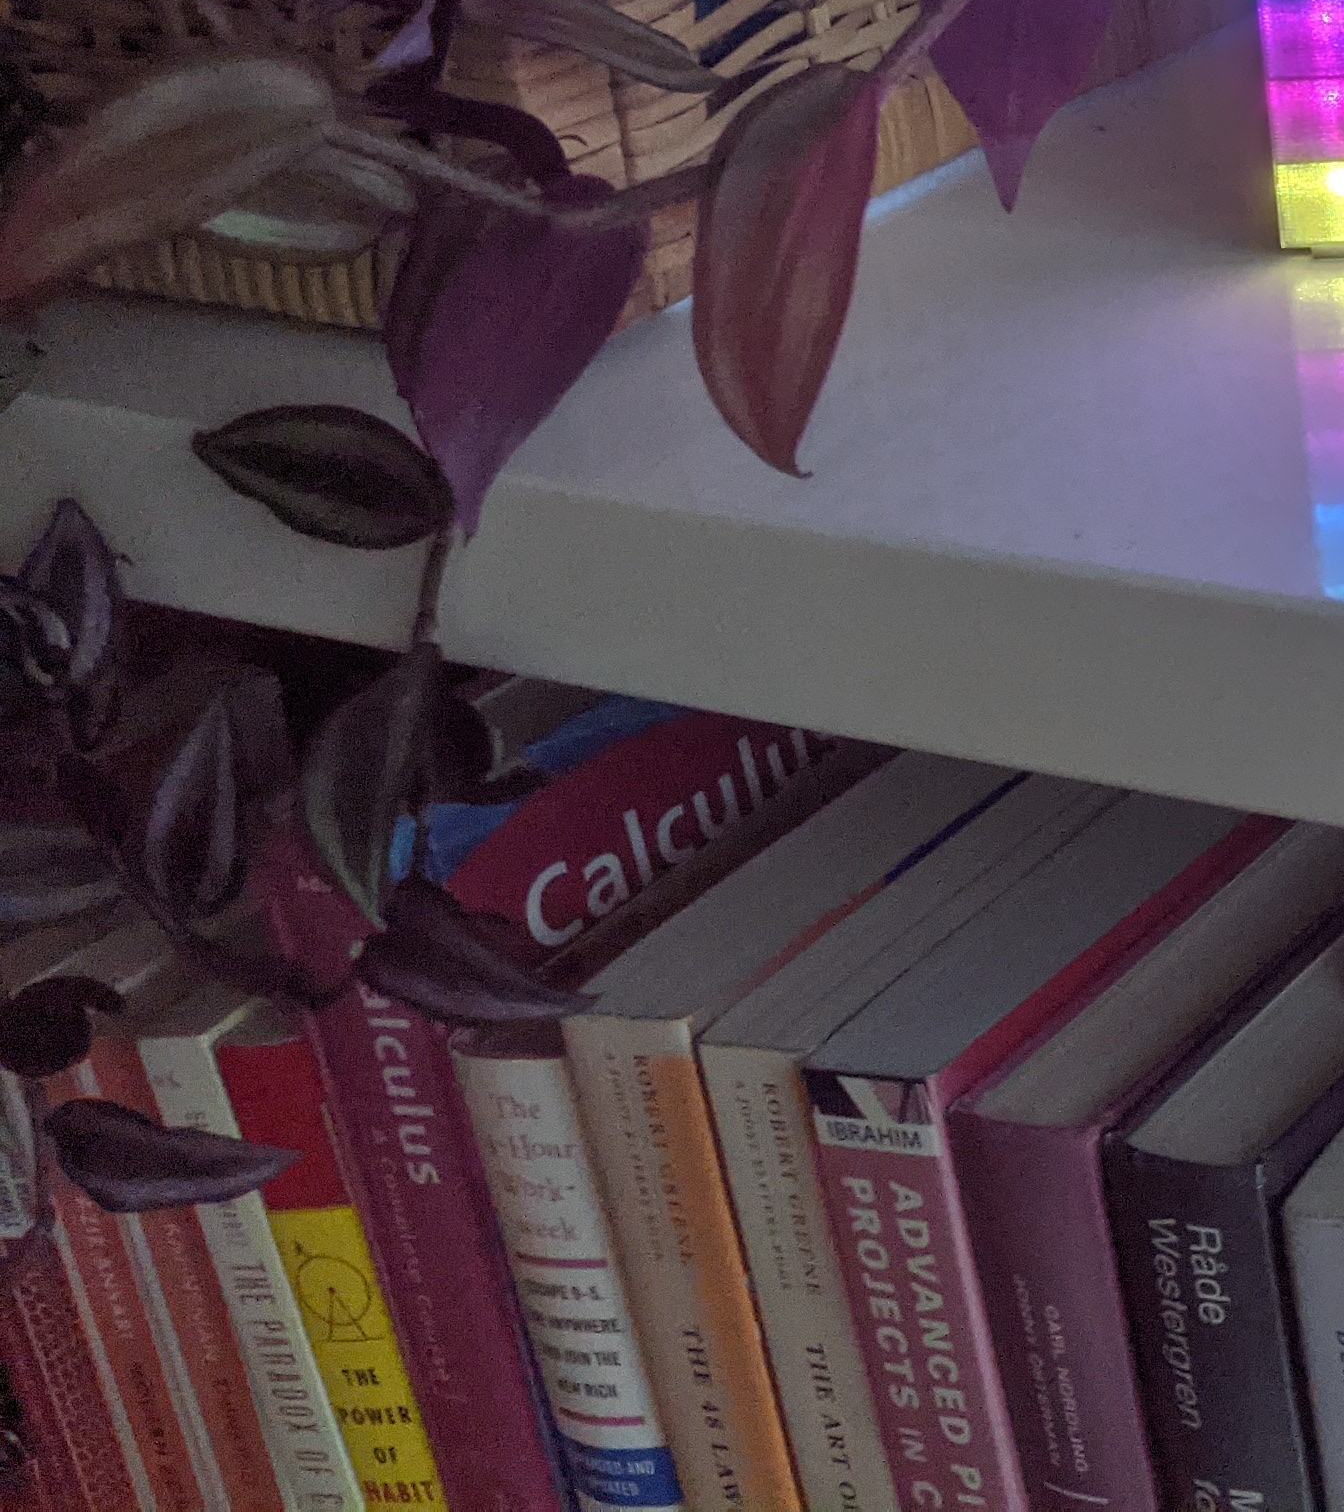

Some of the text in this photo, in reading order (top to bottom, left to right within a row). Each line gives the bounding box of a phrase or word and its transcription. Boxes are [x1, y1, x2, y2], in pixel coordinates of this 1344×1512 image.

[526, 728, 838, 945] Calculu
[358, 983, 441, 1185] alculus
[826, 1119, 922, 1150] IBRAHIM
[233, 1262, 276, 1303] THE
[1186, 1223, 1232, 1326] Råde
[888, 1179, 972, 1445] ADVANCED
[1148, 1218, 1201, 1429] Westergren
[594, 1351, 622, 1366] THE
[682, 1326, 711, 1383] THE
[840, 1177, 942, 1509] PROJECTS IN C
[251, 1320, 319, 1432] PARADOX
[341, 1368, 381, 1387] THE
[337, 1406, 412, 1426] POWER
[806, 1343, 836, 1402] THE
[821, 1413, 851, 1470] ART
[373, 1446, 399, 1465] OF
[627, 1461, 656, 1476] AND
[363, 1480, 437, 1504] HABIT
